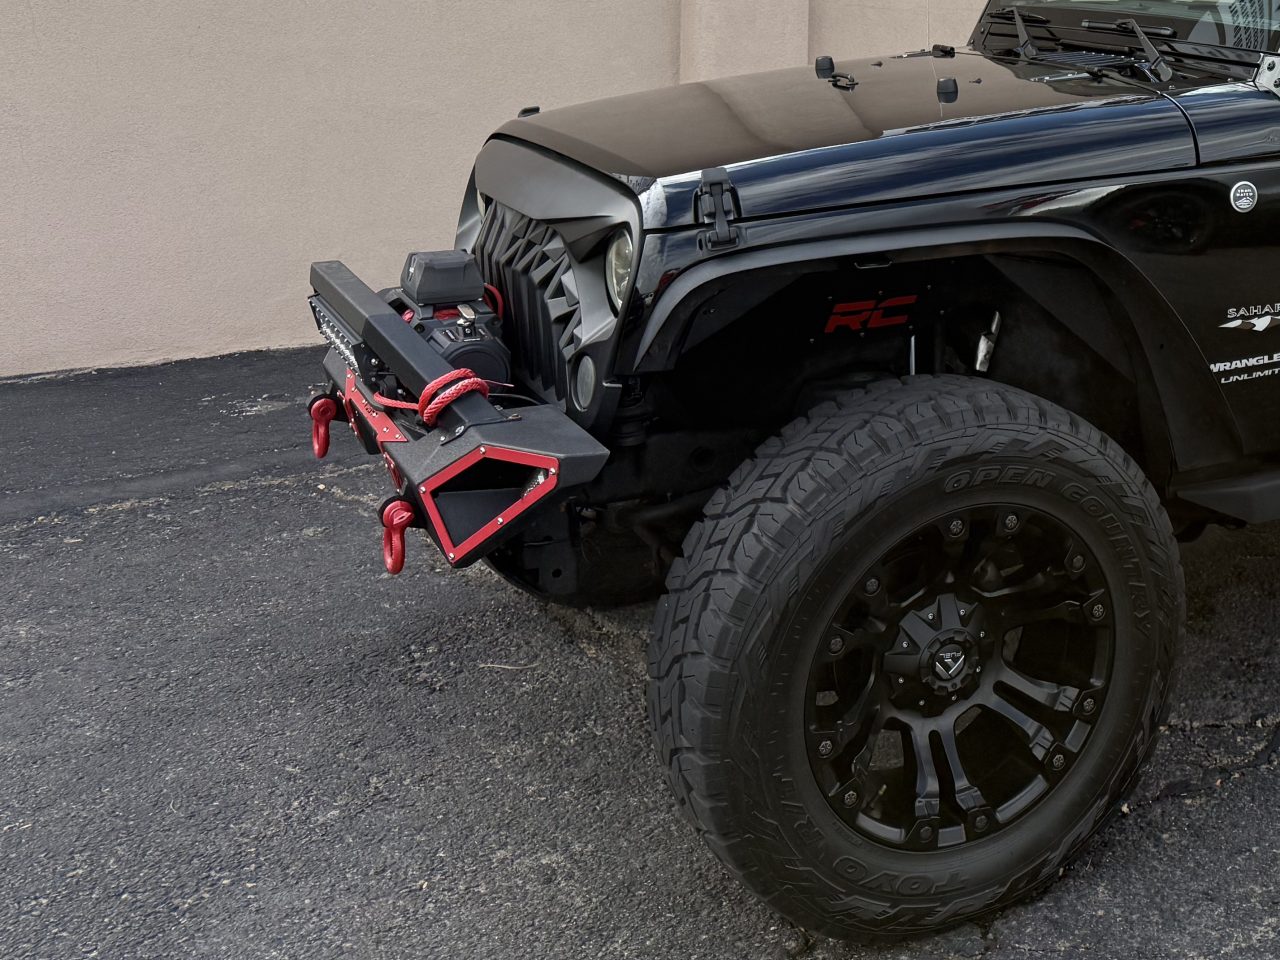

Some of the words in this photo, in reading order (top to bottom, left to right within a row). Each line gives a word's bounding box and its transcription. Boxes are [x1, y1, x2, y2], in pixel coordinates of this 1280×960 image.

[824, 295, 918, 333] RC
[944, 466, 1056, 493] OPEN
[1060, 483, 1152, 639] COUNTRY
[939, 650, 962, 658] FUEL
[833, 855, 969, 897] TOYO
